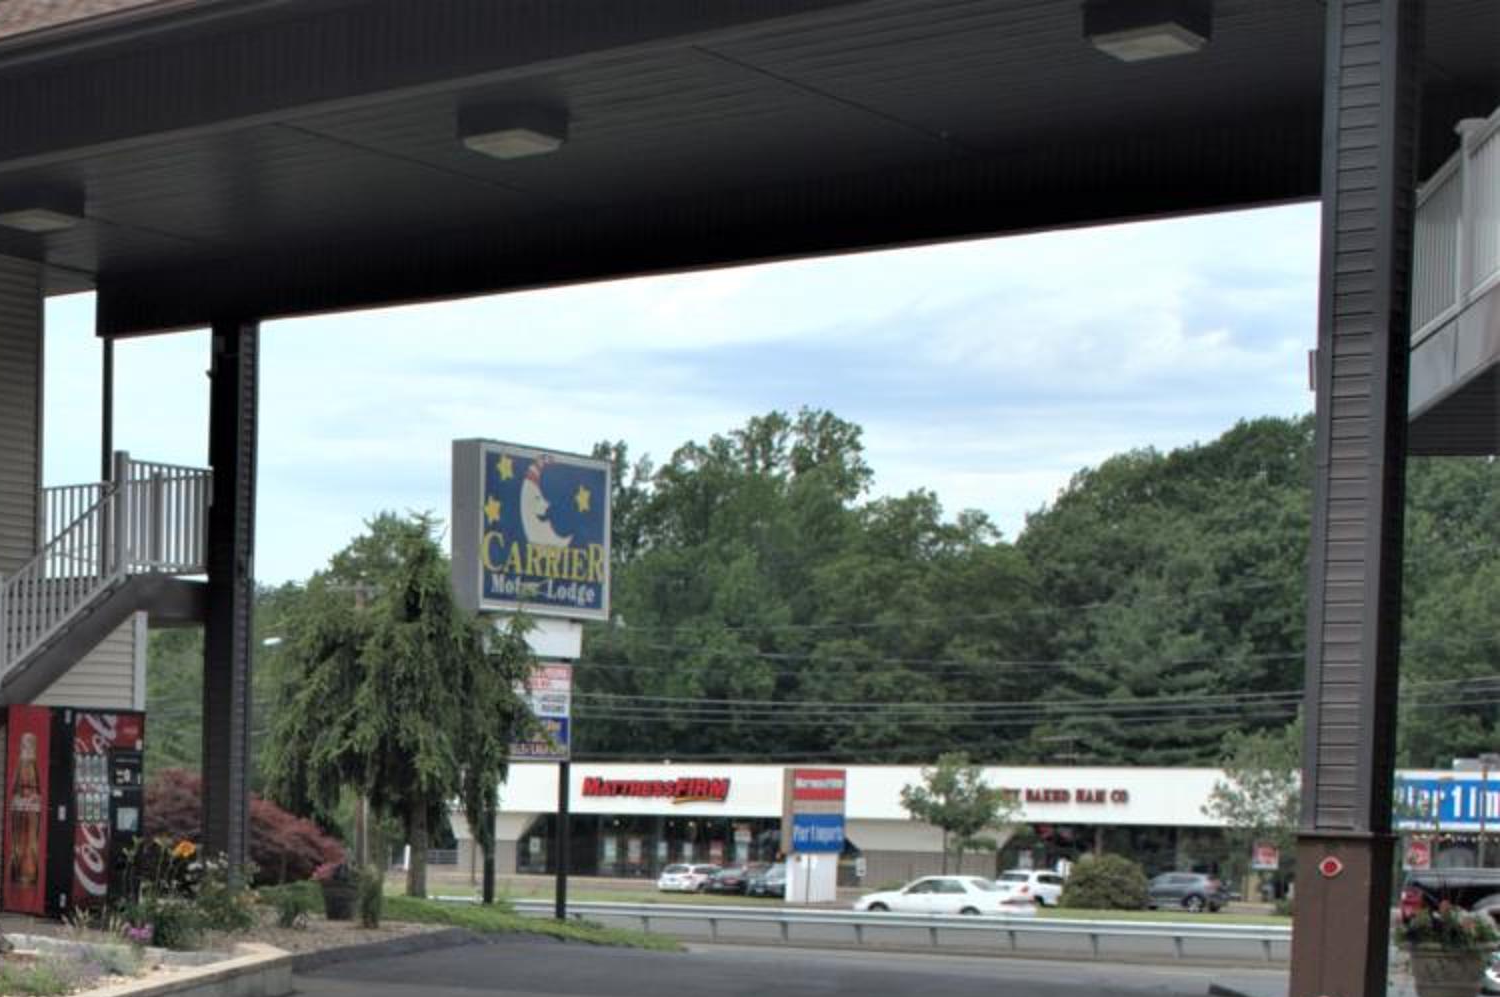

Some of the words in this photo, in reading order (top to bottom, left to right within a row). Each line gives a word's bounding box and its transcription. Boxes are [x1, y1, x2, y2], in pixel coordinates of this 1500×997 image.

[482, 530, 607, 583] CARRIER
[547, 579, 597, 606] Lodge
[1451, 785, 1462, 818] 1
